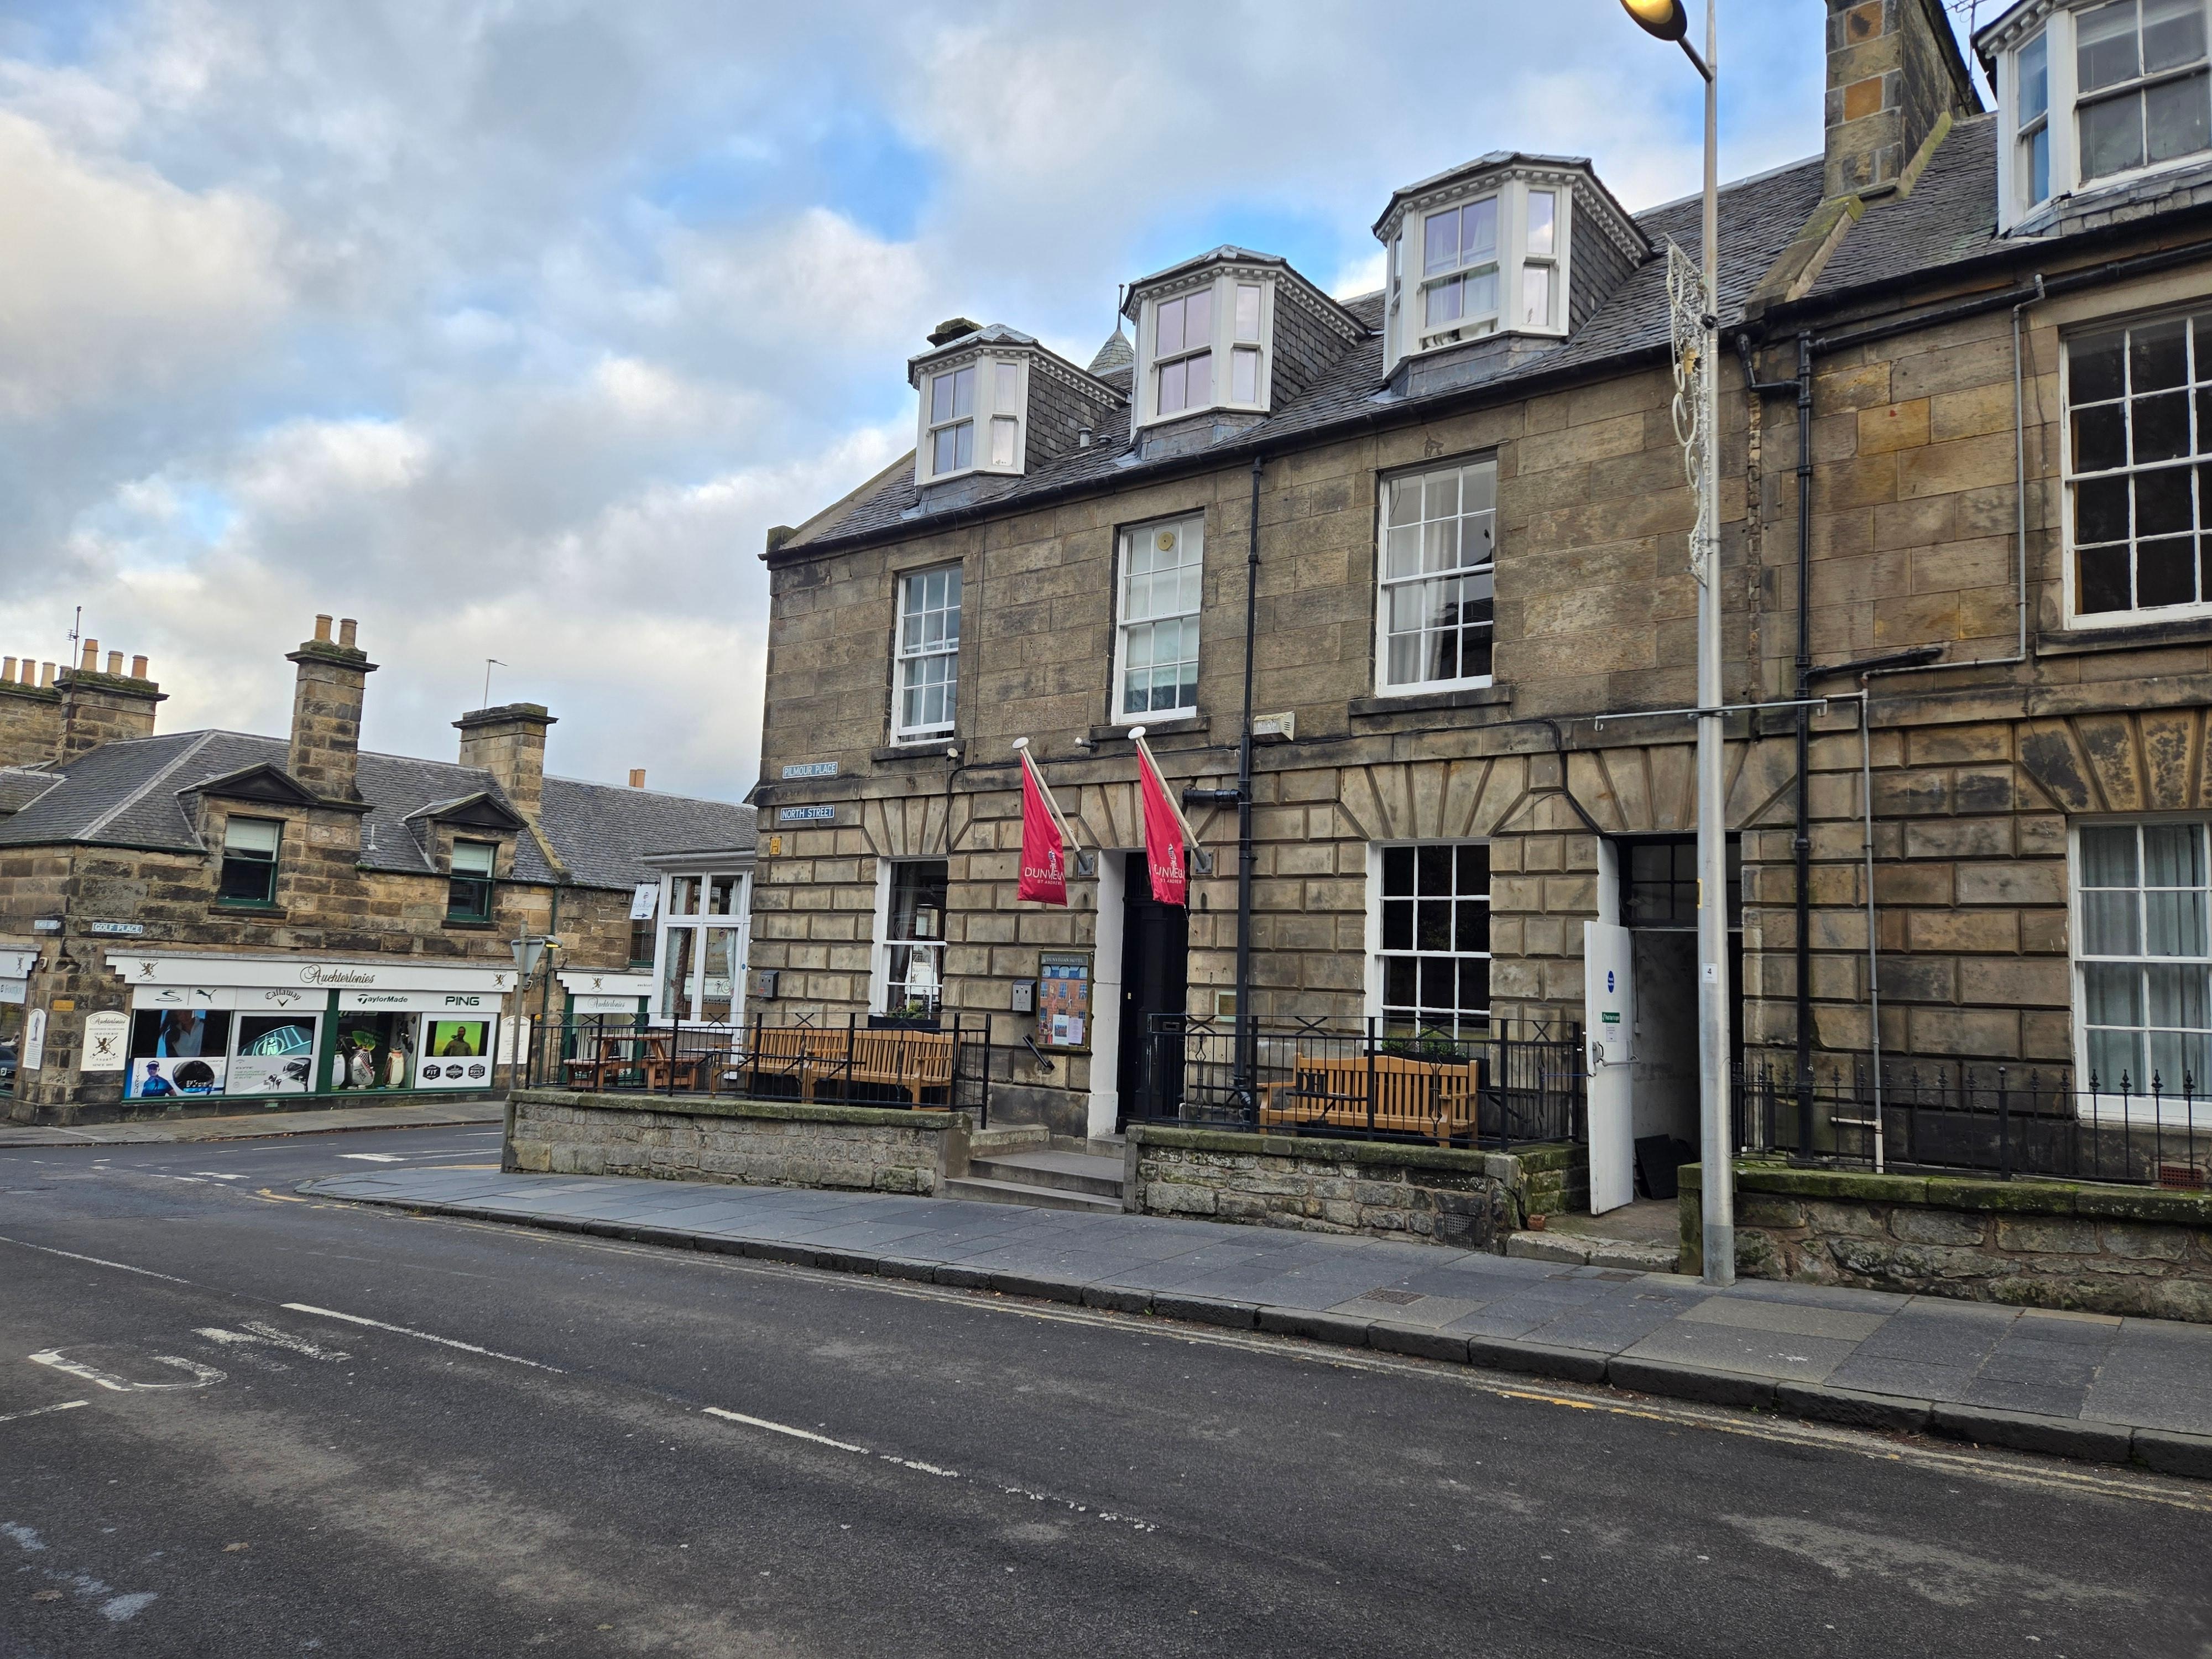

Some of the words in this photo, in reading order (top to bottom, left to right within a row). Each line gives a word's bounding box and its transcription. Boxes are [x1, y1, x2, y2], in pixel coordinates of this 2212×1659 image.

[784, 766, 812, 776] PILMOUR
[815, 764, 836, 774] PLACE
[782, 809, 804, 818] NORTH
[808, 807, 832, 817] STREET
[95, 923, 114, 931] GOLF
[300, 964, 375, 985] Auchterlonies
[265, 988, 302, 1001] Callaway
[357, 994, 408, 1004] TaylorMade
[445, 996, 479, 1006] PING
[588, 996, 625, 1009] Auchterlonies
[90, 1016, 126, 1025] Auchterlonies
